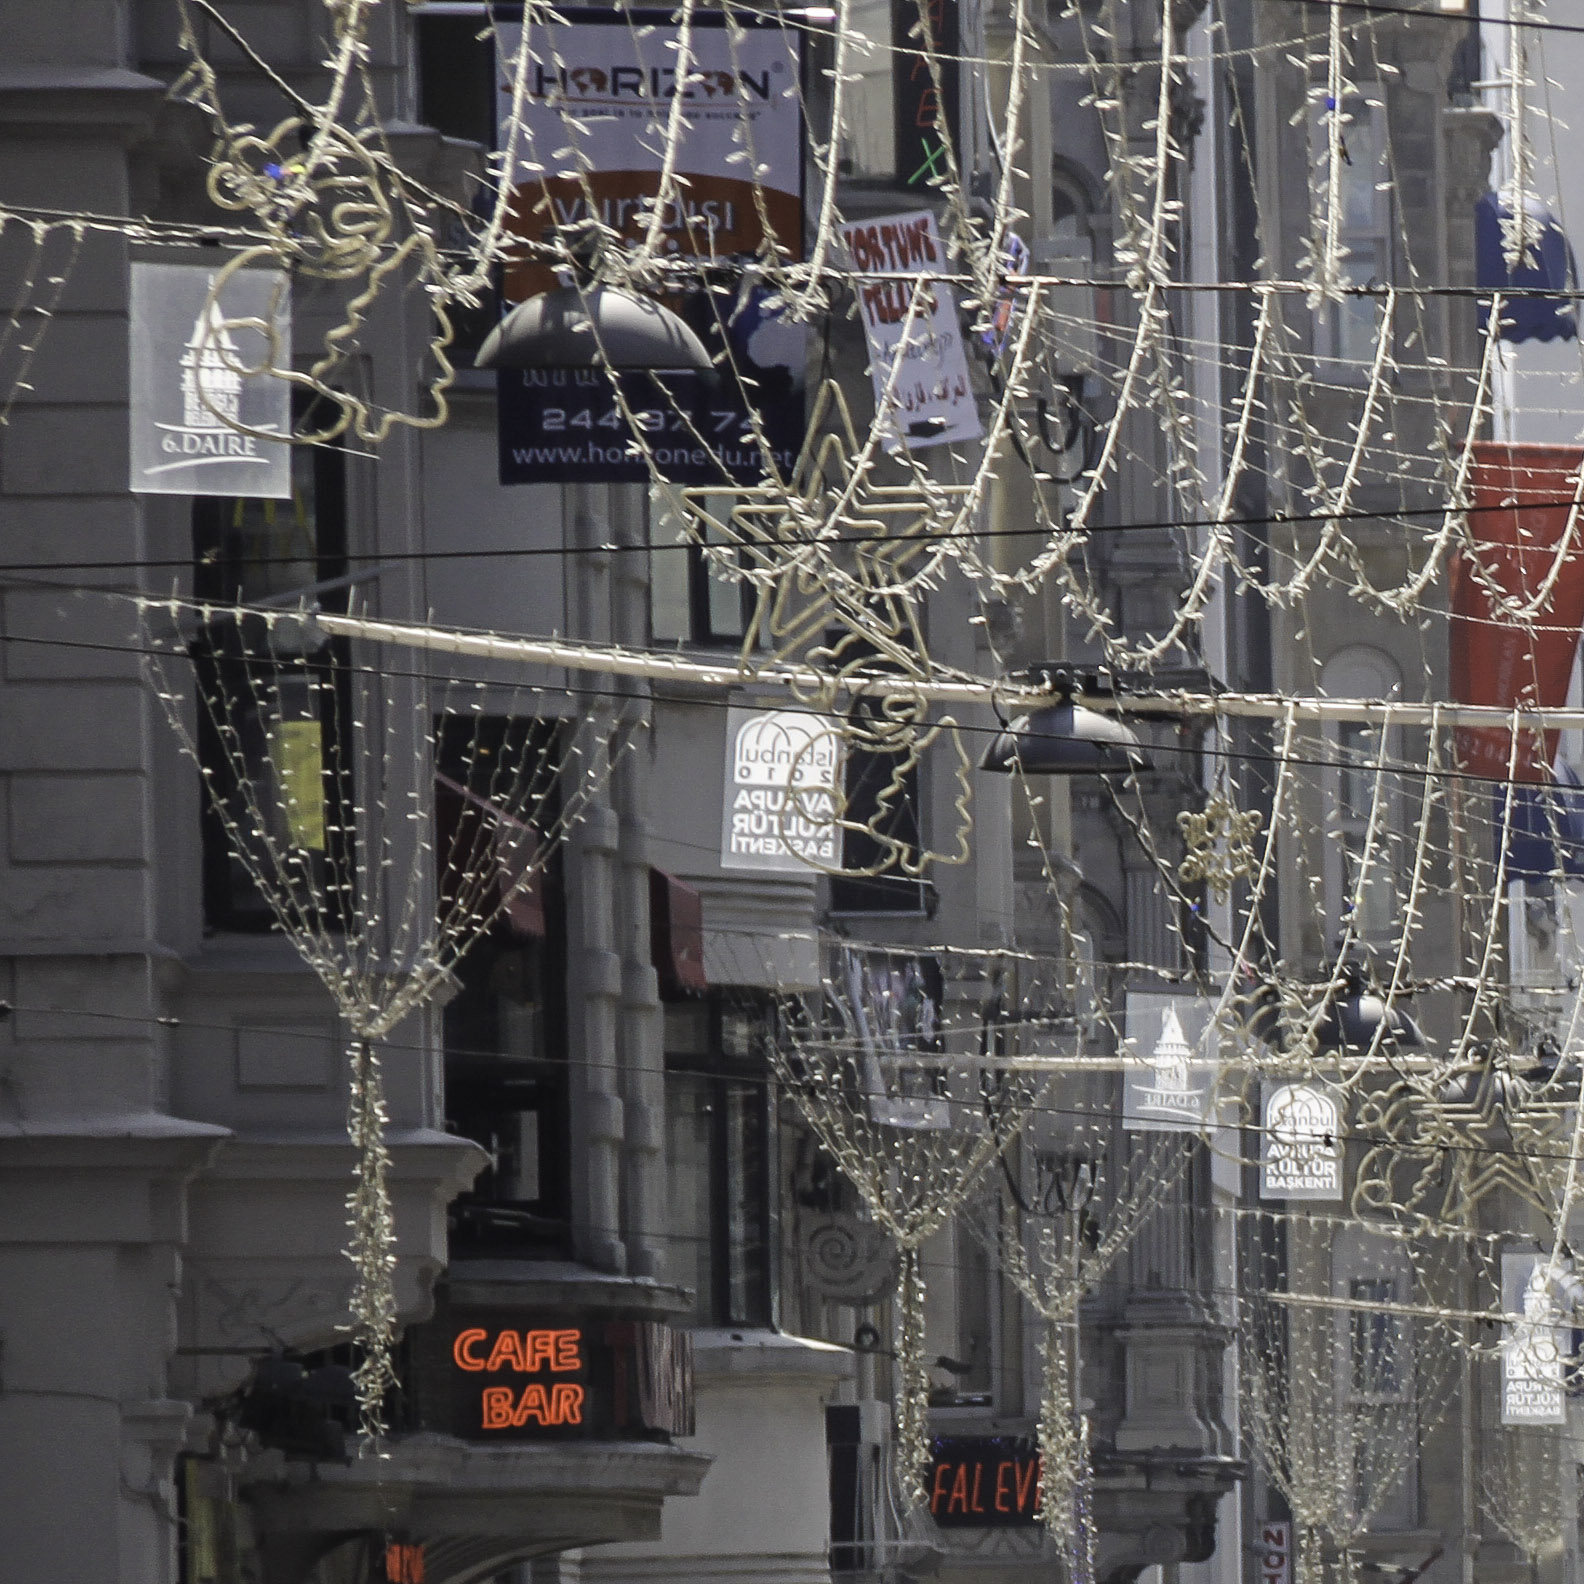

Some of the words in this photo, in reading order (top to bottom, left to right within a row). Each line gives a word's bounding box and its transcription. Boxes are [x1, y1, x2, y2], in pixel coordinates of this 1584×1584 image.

[542, 408, 620, 432] 244
[453, 1328, 582, 1372] CAFE
[481, 1383, 585, 1429] BAR
[931, 1461, 985, 1514] FAL
